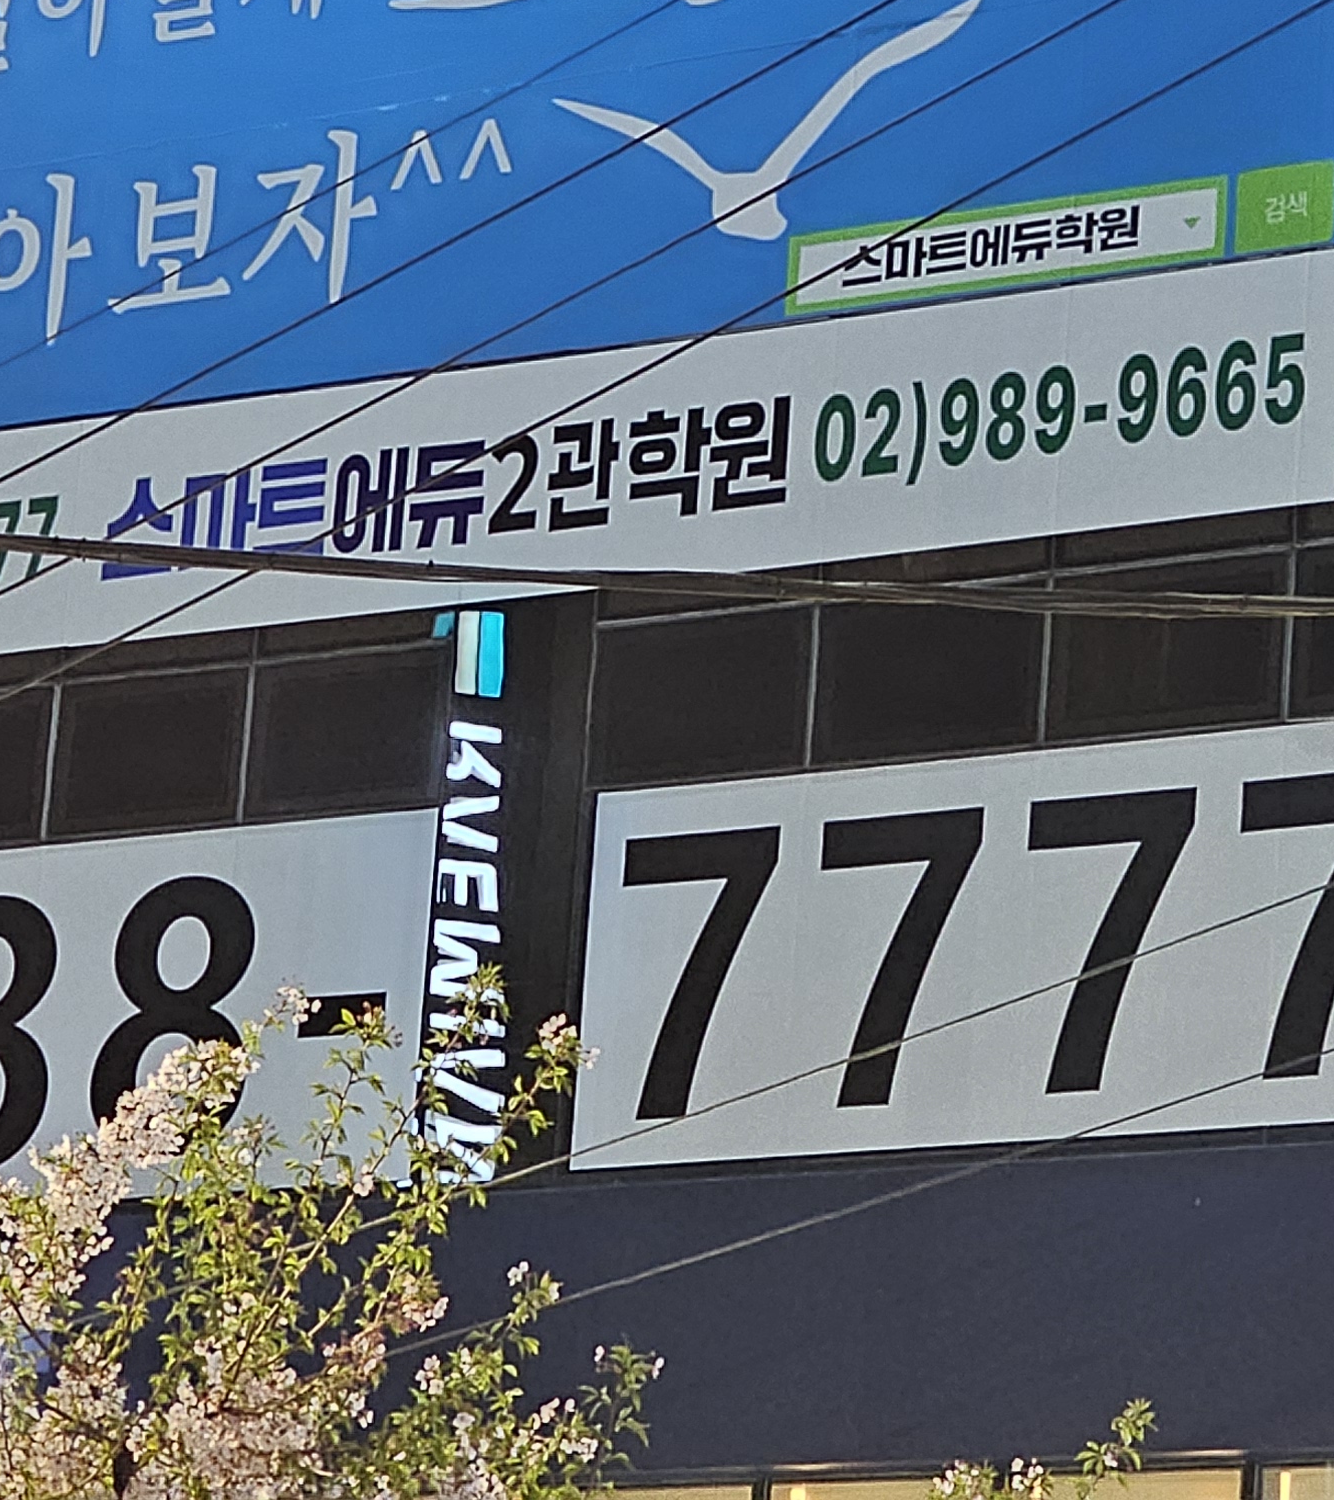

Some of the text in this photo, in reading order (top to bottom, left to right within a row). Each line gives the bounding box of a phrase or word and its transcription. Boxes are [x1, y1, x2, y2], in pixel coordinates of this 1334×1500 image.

[840, 203, 1141, 288] 스마트에듀학원
[1265, 190, 1308, 225] 검색
[812, 331, 1307, 486] 02)989-9665
